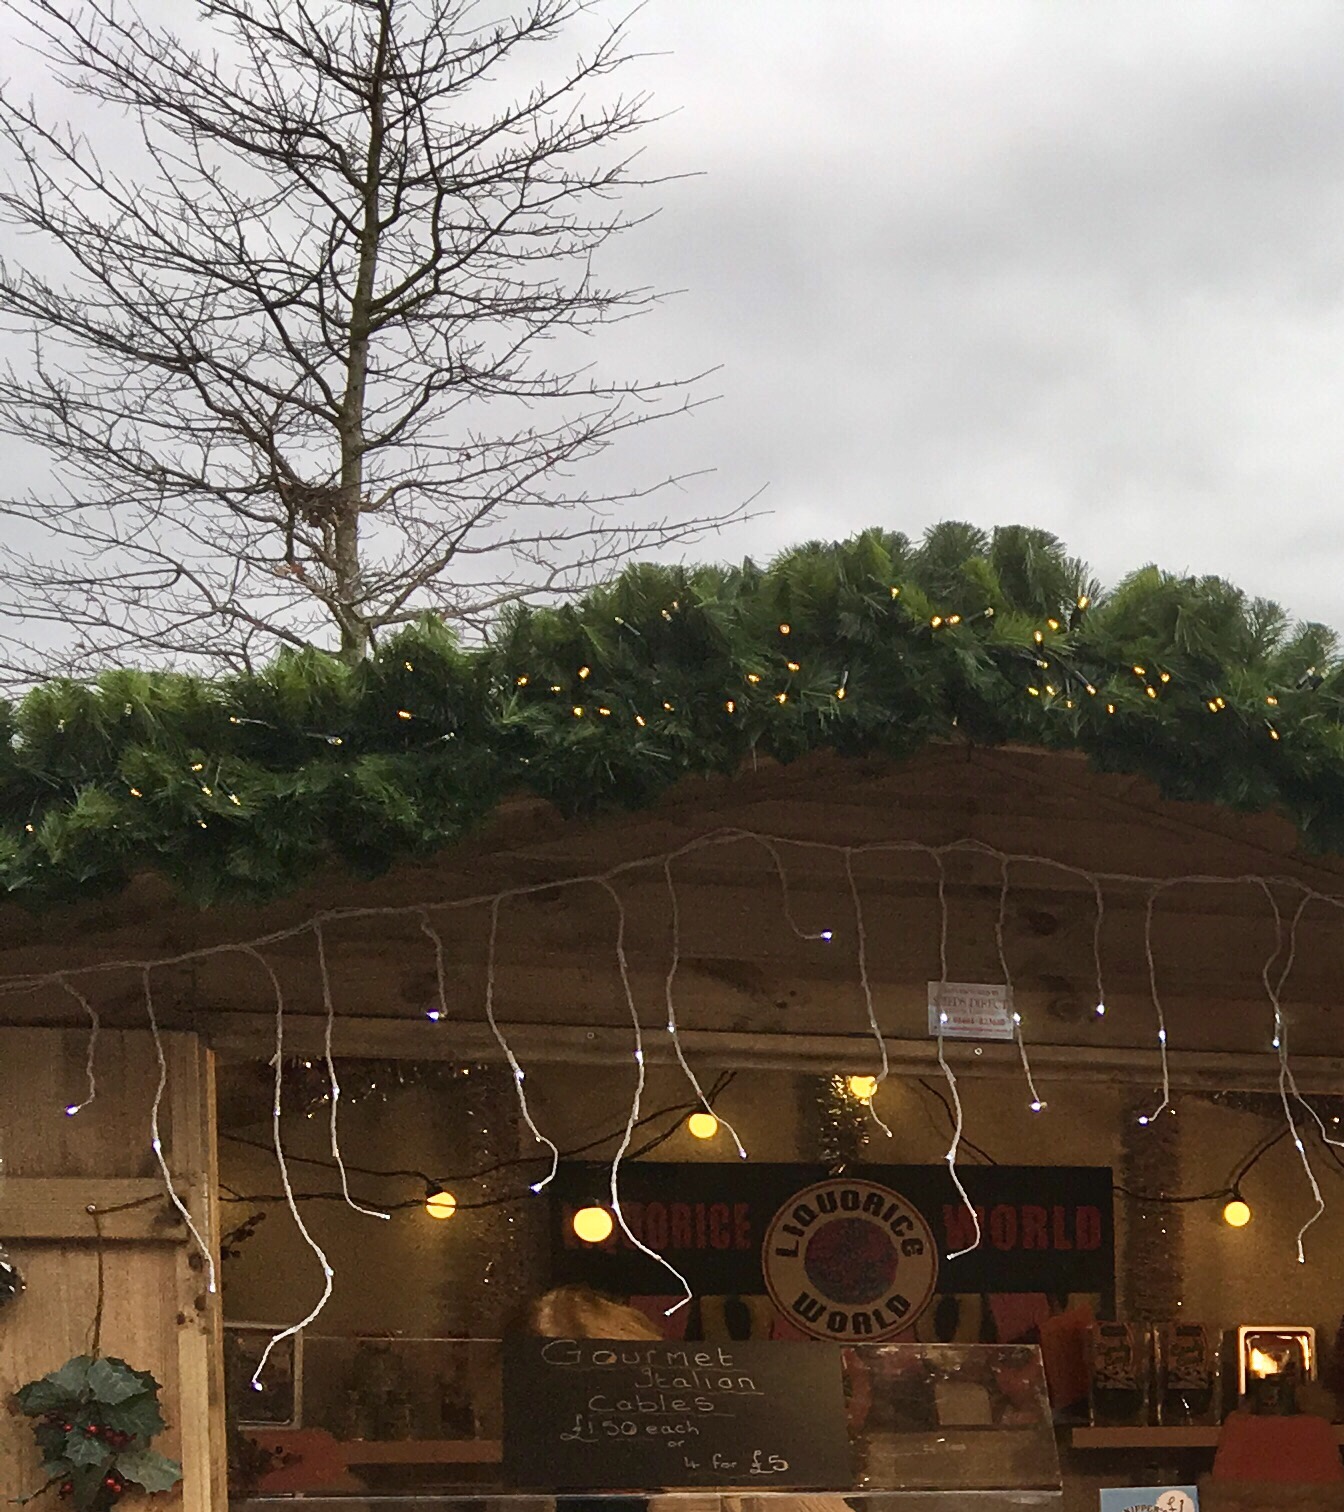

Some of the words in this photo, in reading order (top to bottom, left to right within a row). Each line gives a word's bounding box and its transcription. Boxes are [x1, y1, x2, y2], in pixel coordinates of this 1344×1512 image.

[775, 1190, 924, 1258] LIQUORICE
[943, 1205, 1101, 1249] WORLD
[791, 1292, 912, 1335] WORLD
[645, 1420, 700, 1436] each
[683, 1457, 701, 1468] 4
[712, 1453, 738, 1469] for
[749, 1450, 789, 1474] £5
